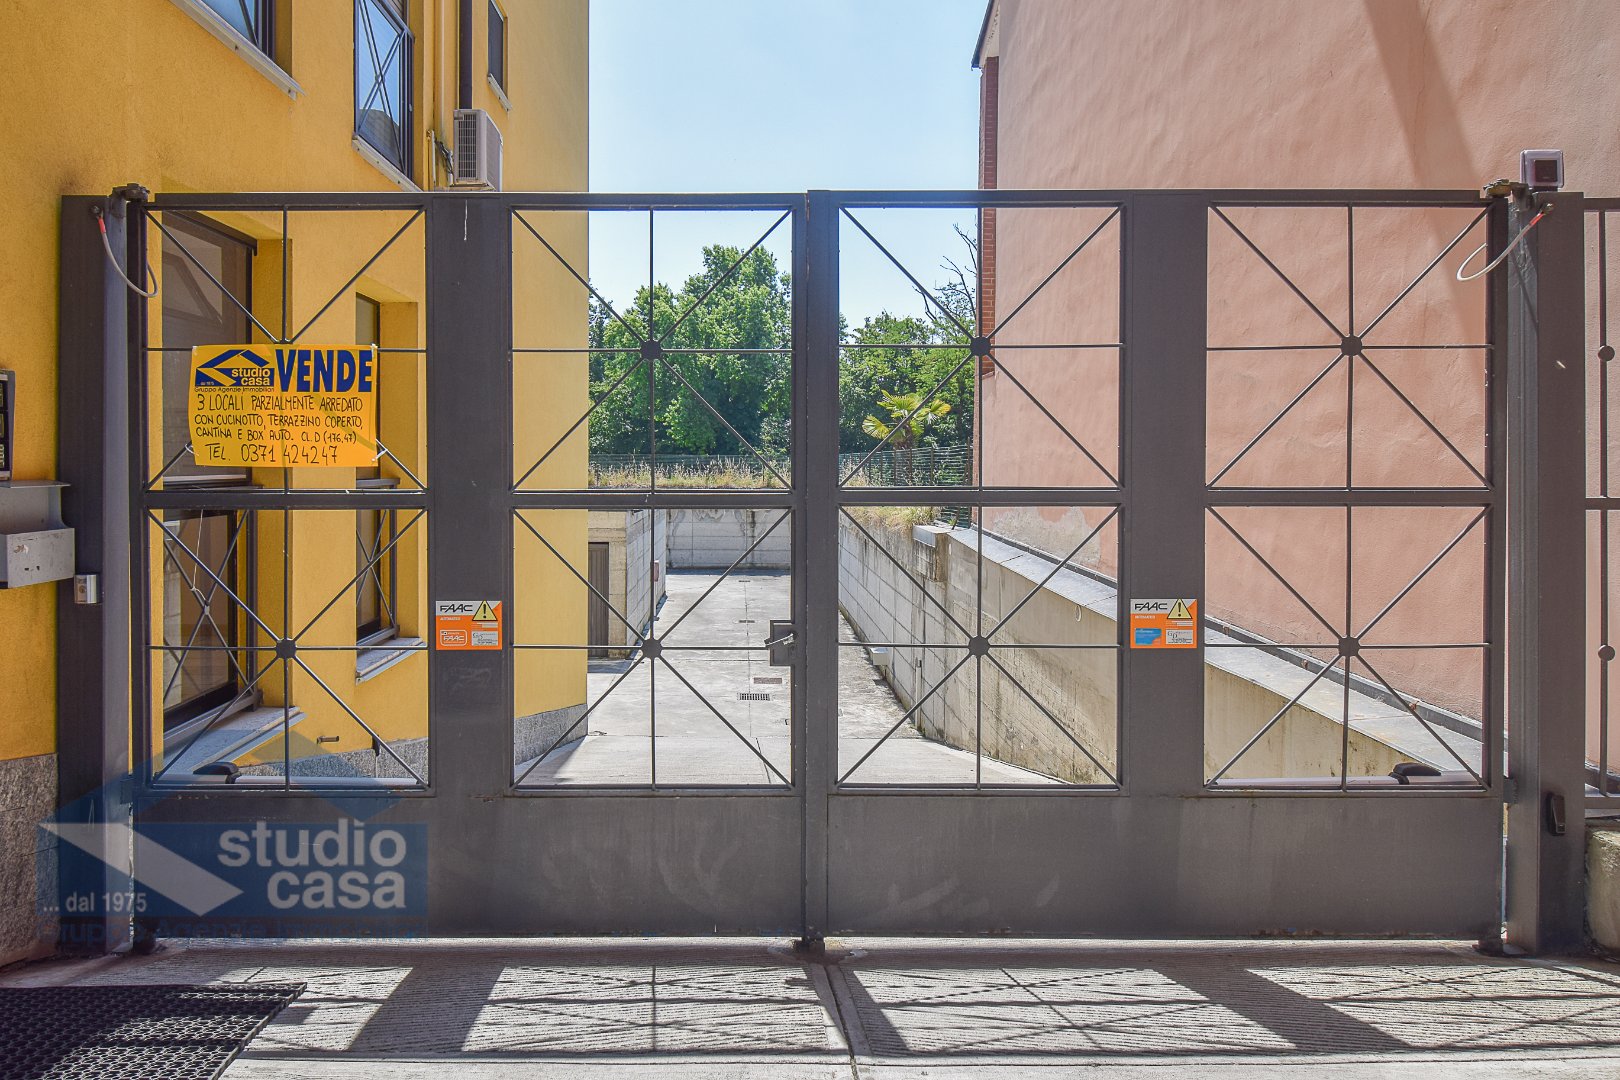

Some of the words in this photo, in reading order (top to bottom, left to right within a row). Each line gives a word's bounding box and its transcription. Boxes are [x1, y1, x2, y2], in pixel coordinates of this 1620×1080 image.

[231, 367, 271, 378] studio
[275, 349, 372, 392] VENDE
[240, 377, 271, 386] casa
[218, 387, 241, 395] Agenzie
[197, 394, 205, 411] 3
[209, 392, 244, 411] LOCALI
[251, 395, 315, 411] PARZIALMENTE
[319, 397, 363, 412] ARREDATO
[194, 414, 214, 425] CON
[216, 413, 266, 430] CUCINOTTO,
[267, 413, 321, 427] TERRAZZINO
[324, 415, 363, 430] COPERTO,
[195, 426, 232, 439] CANTINA
[237, 429, 243, 439] E
[247, 429, 264, 441] BOX
[205, 442, 231, 461] TEL.
[241, 443, 276, 462] 0371
[283, 444, 338, 466] 424247
[440, 604, 473, 613] FAAC
[1134, 601, 1168, 612] FAAC
